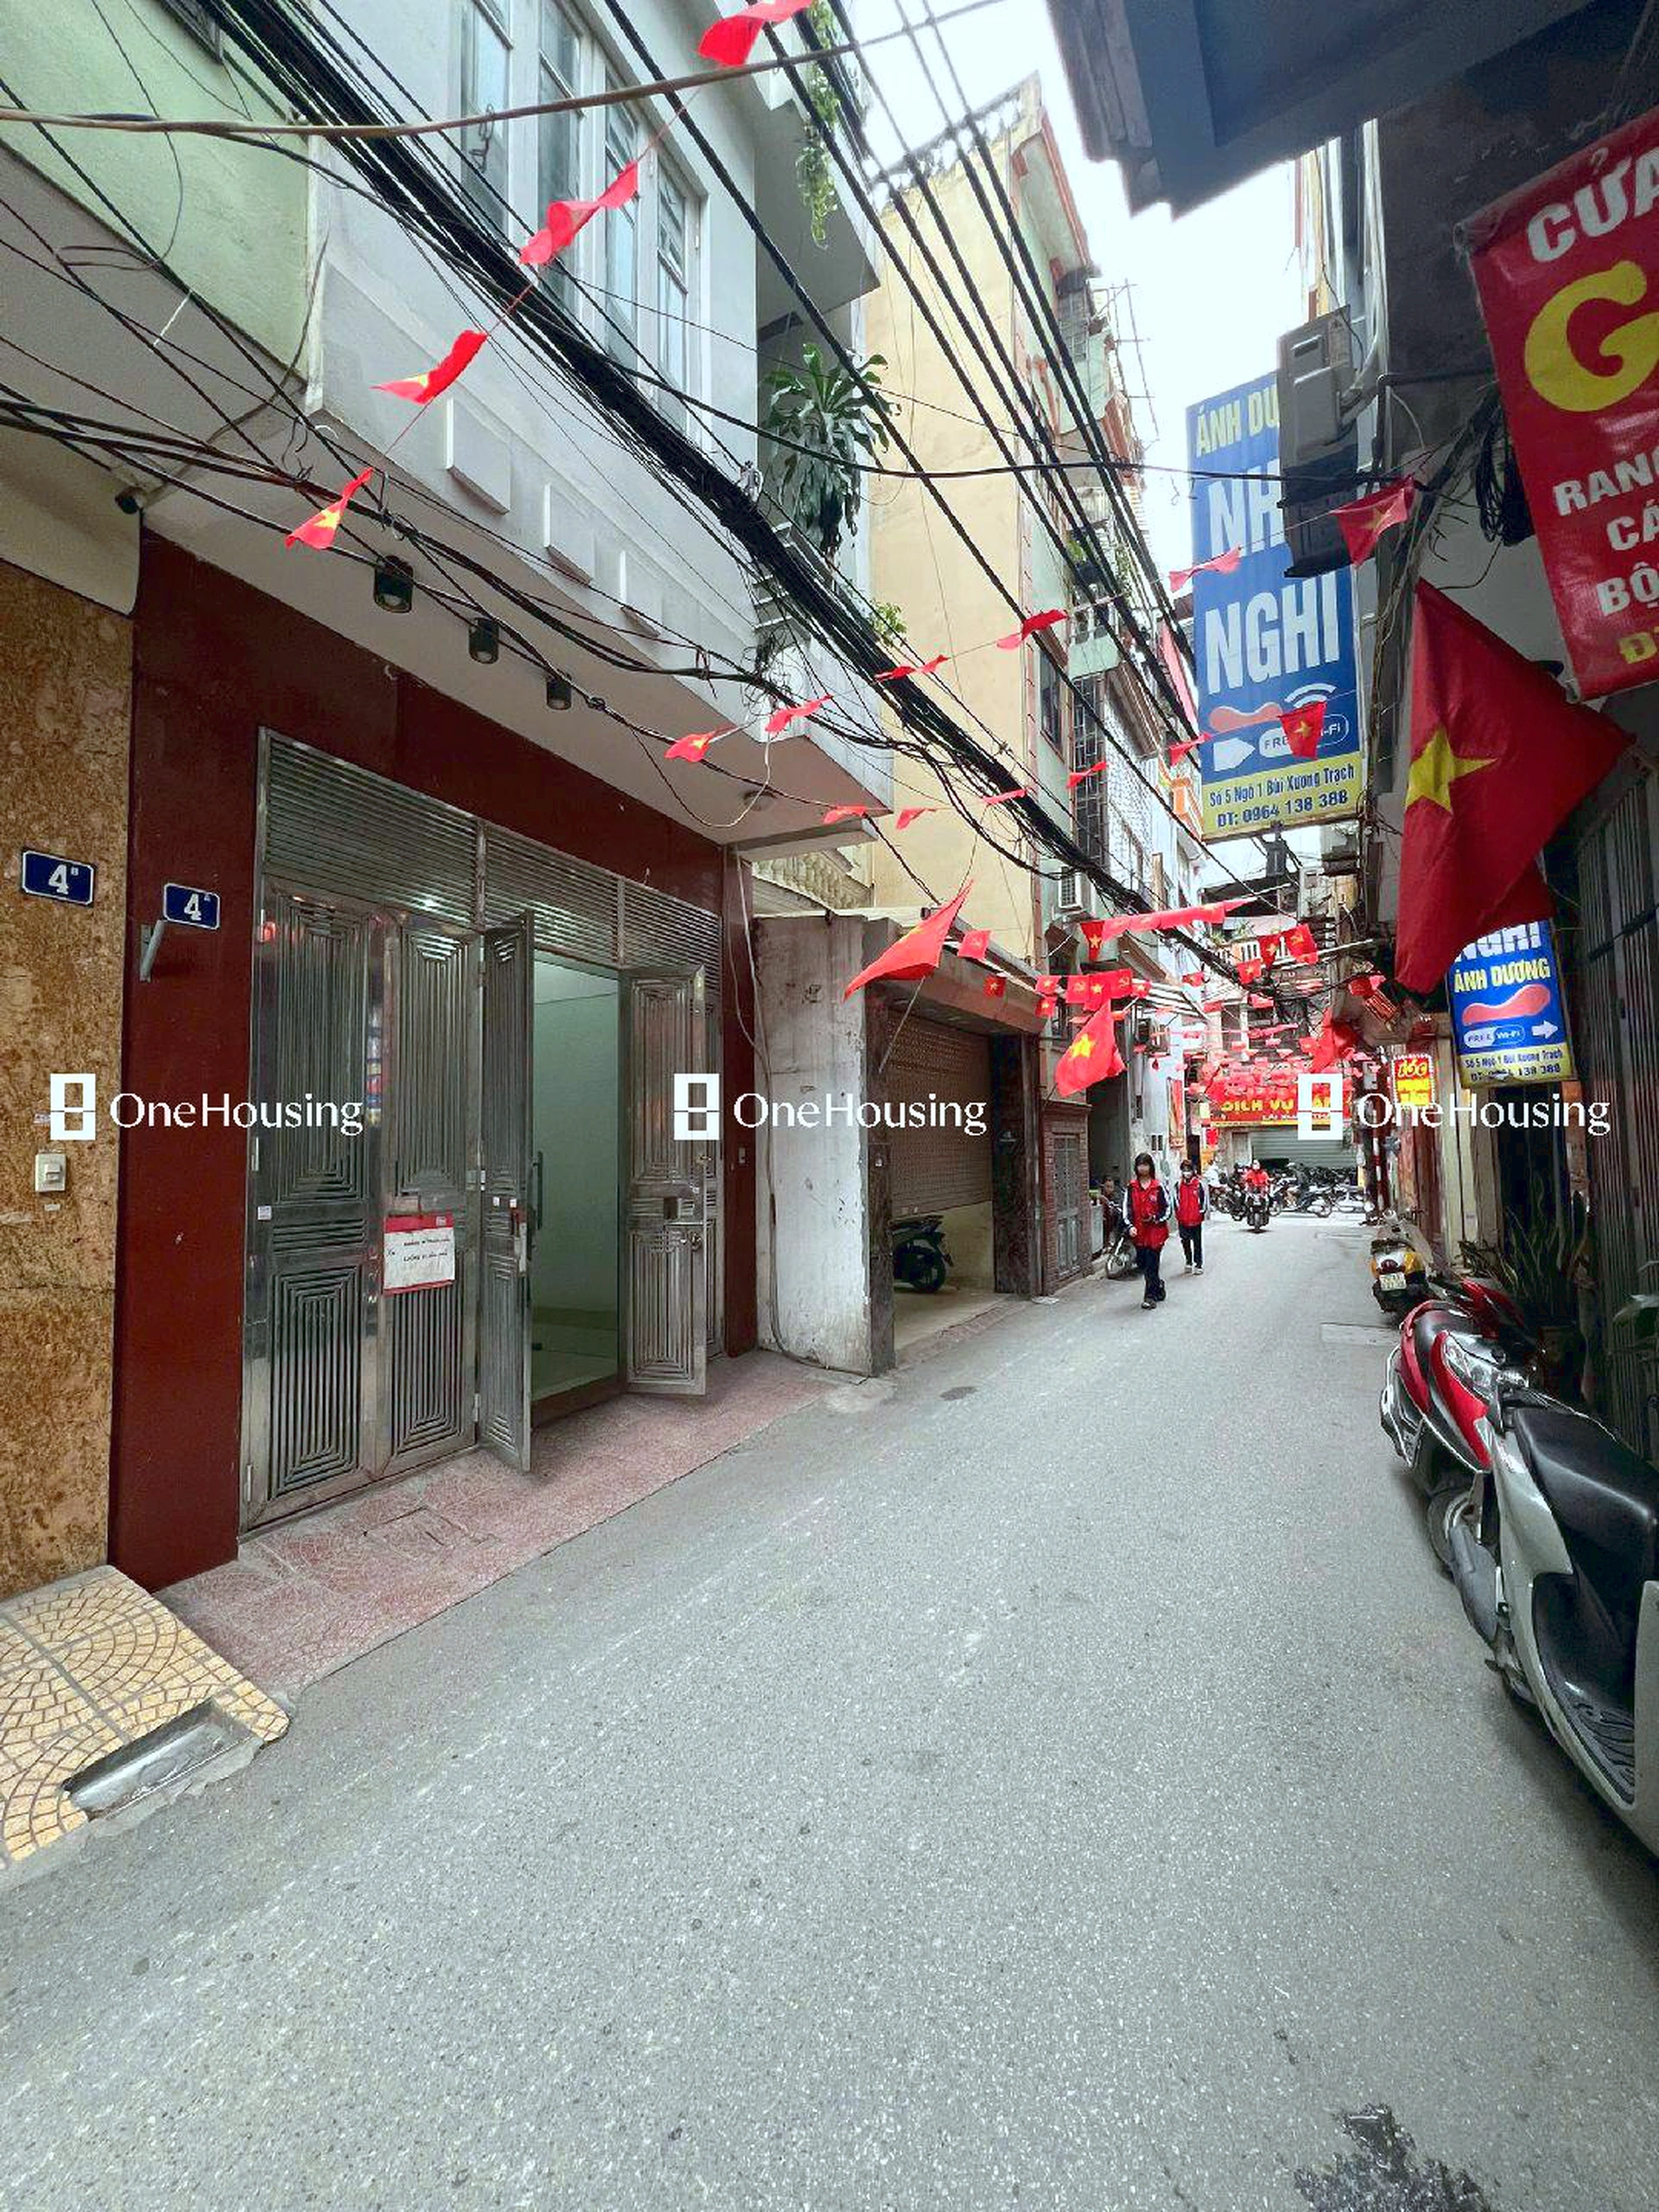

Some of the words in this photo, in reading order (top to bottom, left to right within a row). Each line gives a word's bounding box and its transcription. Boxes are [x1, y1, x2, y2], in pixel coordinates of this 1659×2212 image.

[1196, 400, 1242, 458] ÁNH
[1225, 789, 1232, 804] 5
[1257, 783, 1263, 797] 1
[1323, 763, 1354, 785] Trạch
[1243, 804, 1279, 821] 0964
[1285, 797, 1313, 814] 138
[1319, 789, 1348, 808] 388
[1454, 968, 1487, 992] ÁNH
